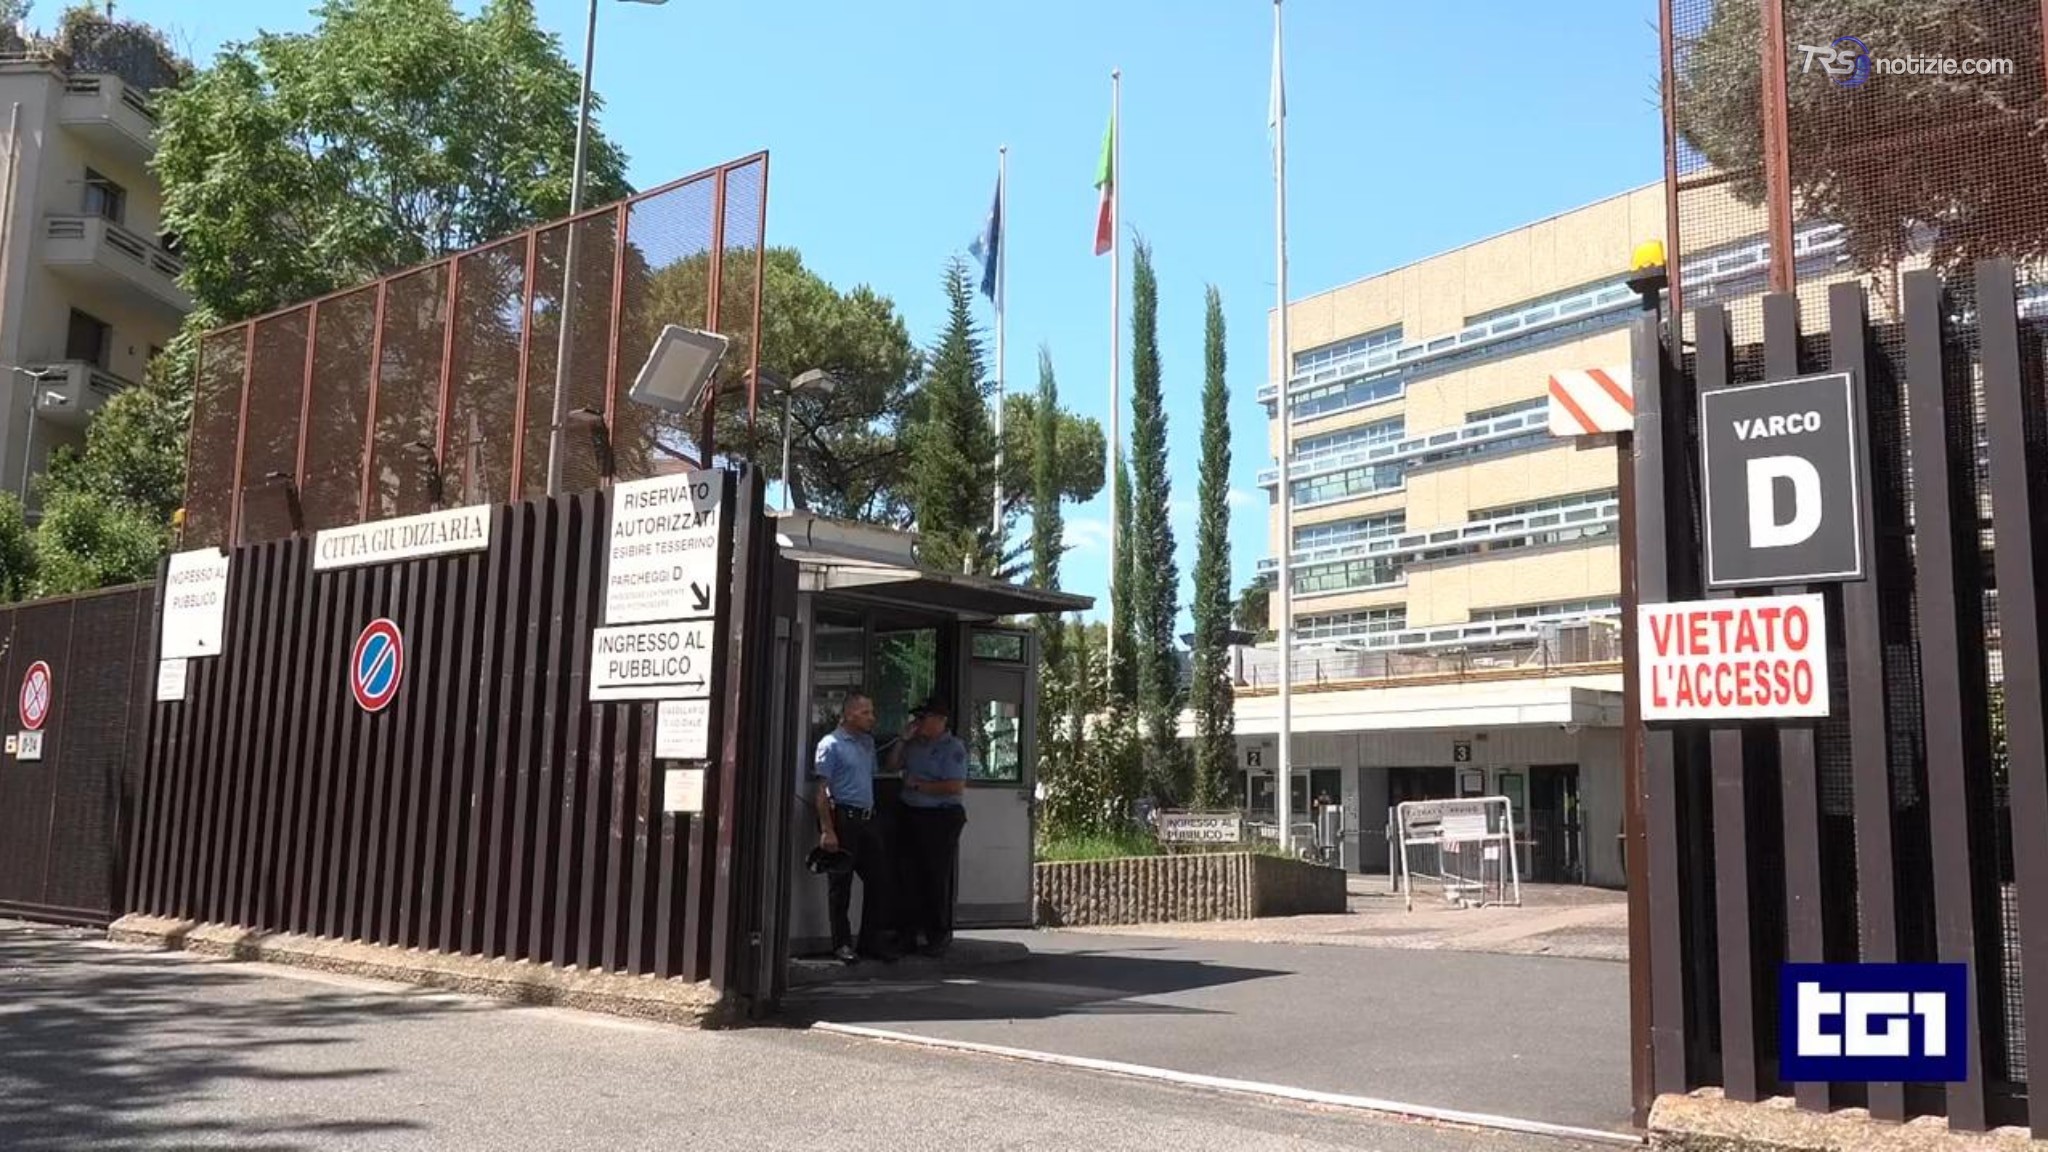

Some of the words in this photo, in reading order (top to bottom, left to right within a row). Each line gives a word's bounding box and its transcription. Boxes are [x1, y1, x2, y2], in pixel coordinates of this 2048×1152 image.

[1732, 410, 1821, 441] VARCO
[624, 482, 709, 511] RISERVATO
[1746, 455, 1823, 549] D
[371, 515, 483, 552] GIUDIZIARIA
[614, 510, 715, 538] AUTORIZZATI
[612, 543, 652, 559] ESIBIRE
[655, 535, 715, 554] TESSERINO
[169, 567, 213, 585] INGRESSO
[611, 570, 670, 587] PARCHEGGI
[672, 565, 683, 581] D
[172, 591, 217, 610] PUBBLICO
[598, 631, 680, 655] INGRESSO
[684, 630, 706, 650] AL
[1649, 605, 1810, 657] VIETATO
[608, 655, 691, 680] PUBBLICO
[1652, 658, 1813, 707] L'ACCESSO
[1458, 746, 1467, 761] 3
